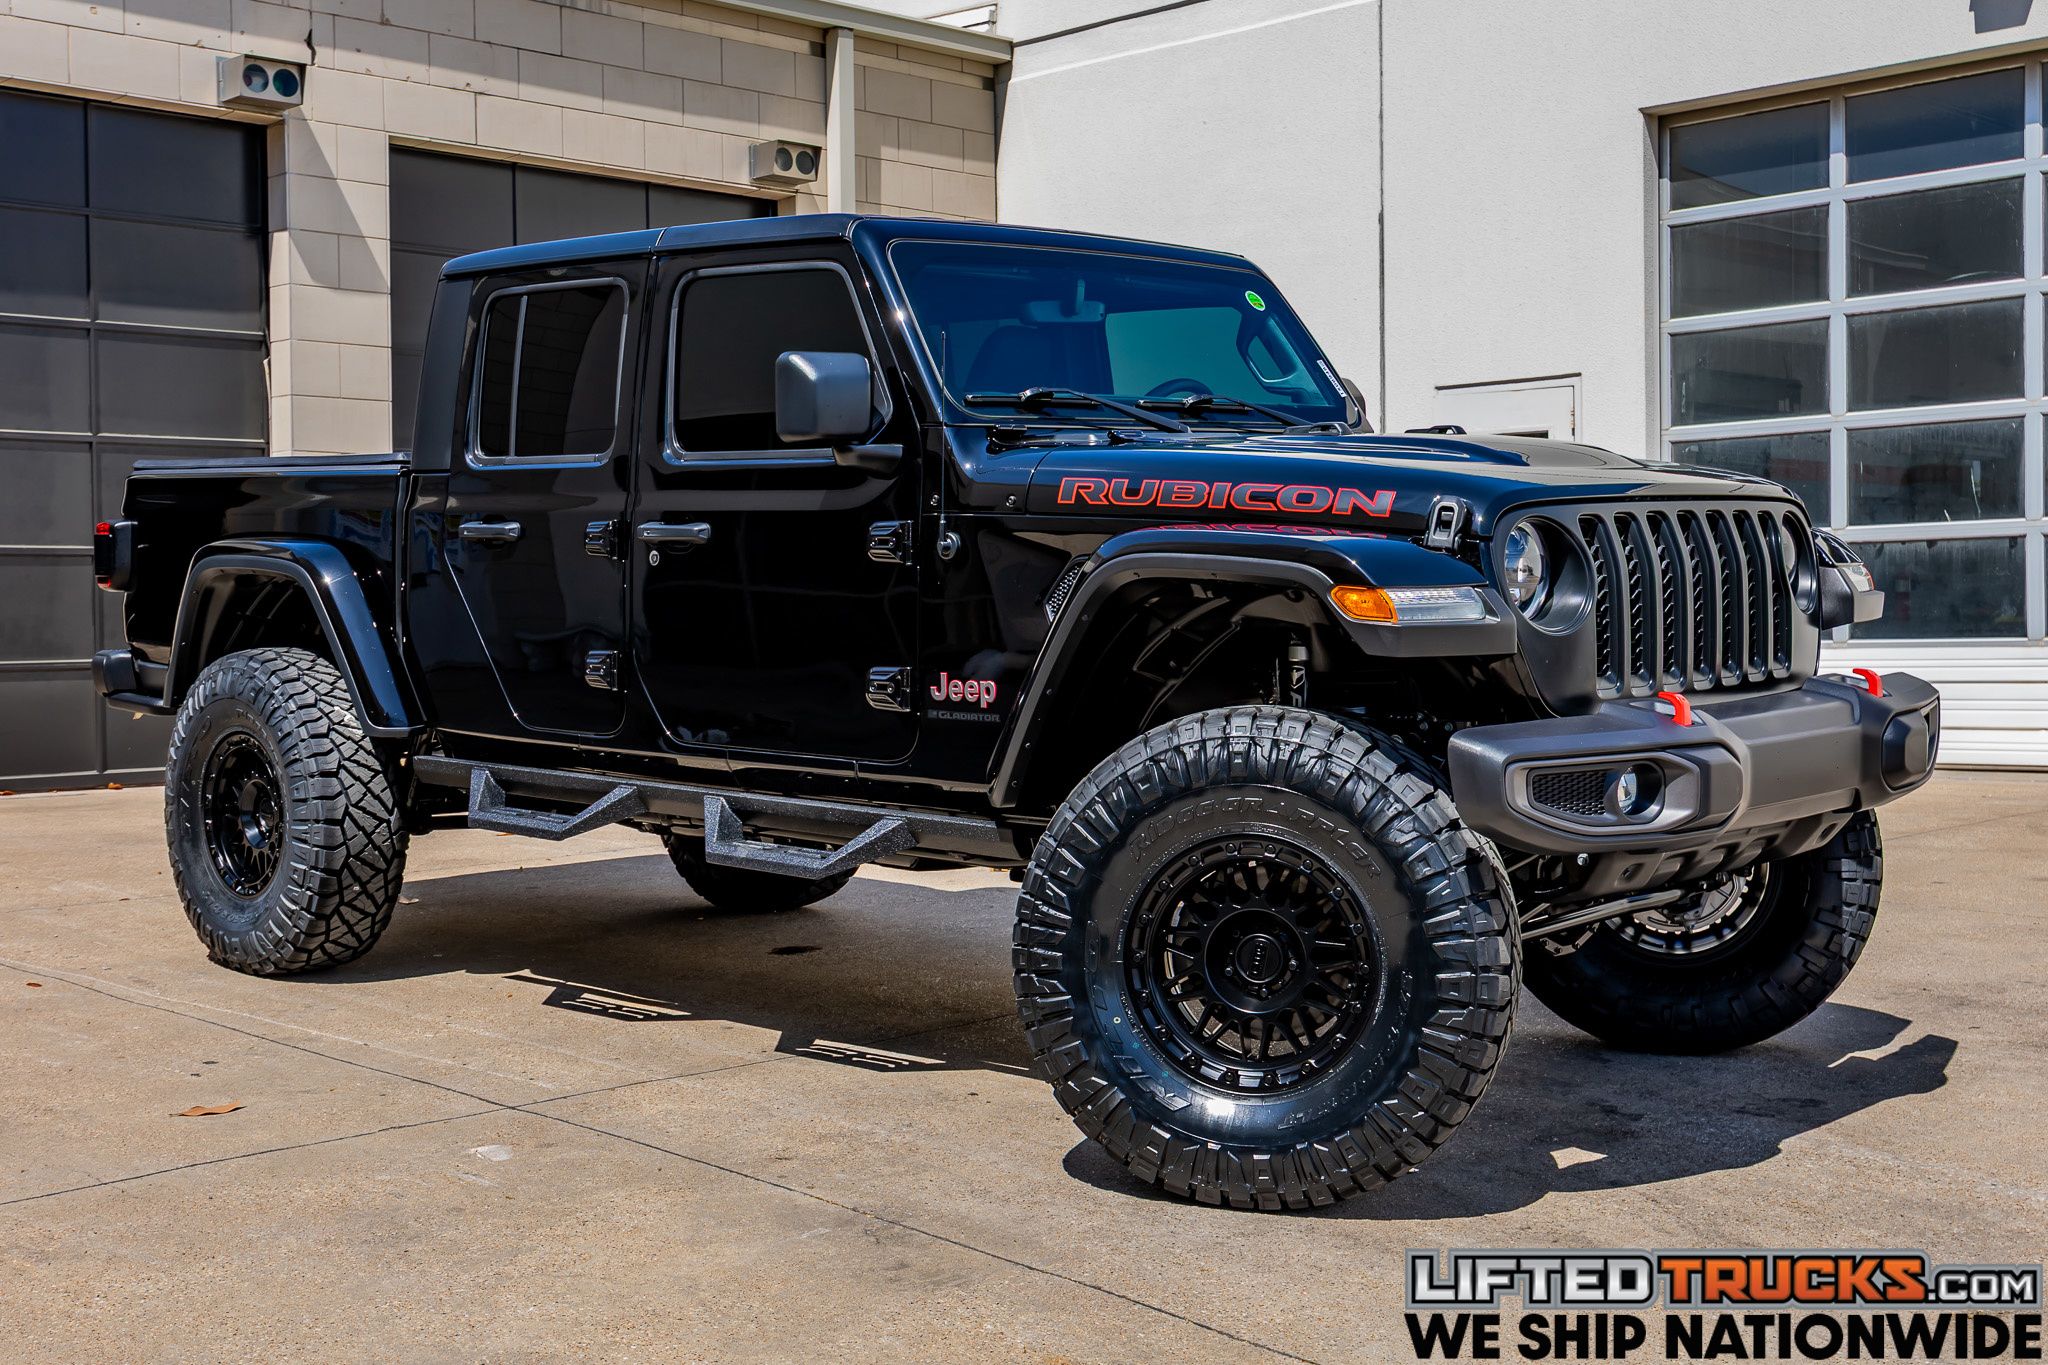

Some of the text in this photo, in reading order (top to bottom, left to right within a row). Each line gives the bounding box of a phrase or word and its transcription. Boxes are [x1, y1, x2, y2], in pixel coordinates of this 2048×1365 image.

[1057, 476, 1397, 518] RUBICON
[930, 672, 997, 709] Jeep
[938, 710, 1001, 722] GLADIATOR
